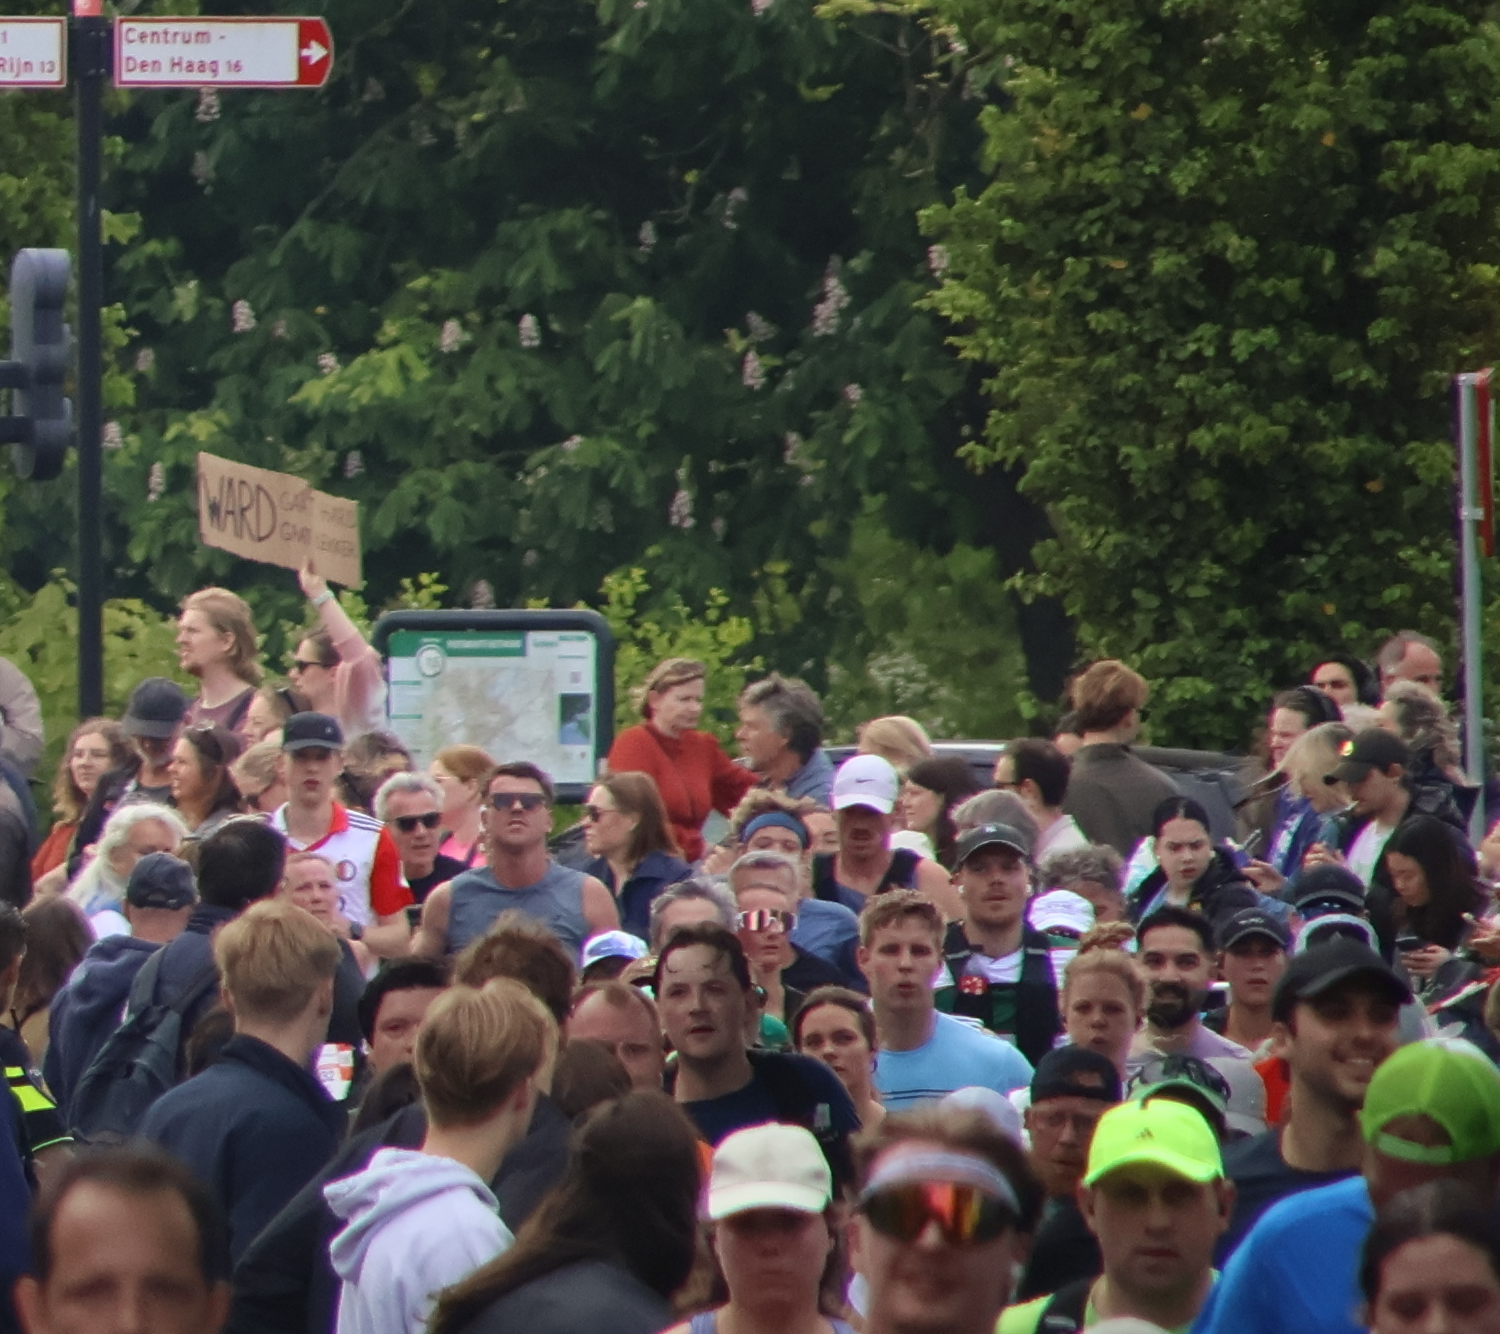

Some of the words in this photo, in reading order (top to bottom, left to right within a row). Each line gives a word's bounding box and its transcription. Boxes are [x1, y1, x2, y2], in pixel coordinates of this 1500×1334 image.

[124, 27, 211, 44] Centrum
[124, 57, 162, 73] Den
[169, 56, 220, 77] Haag
[202, 473, 277, 542] WARD
